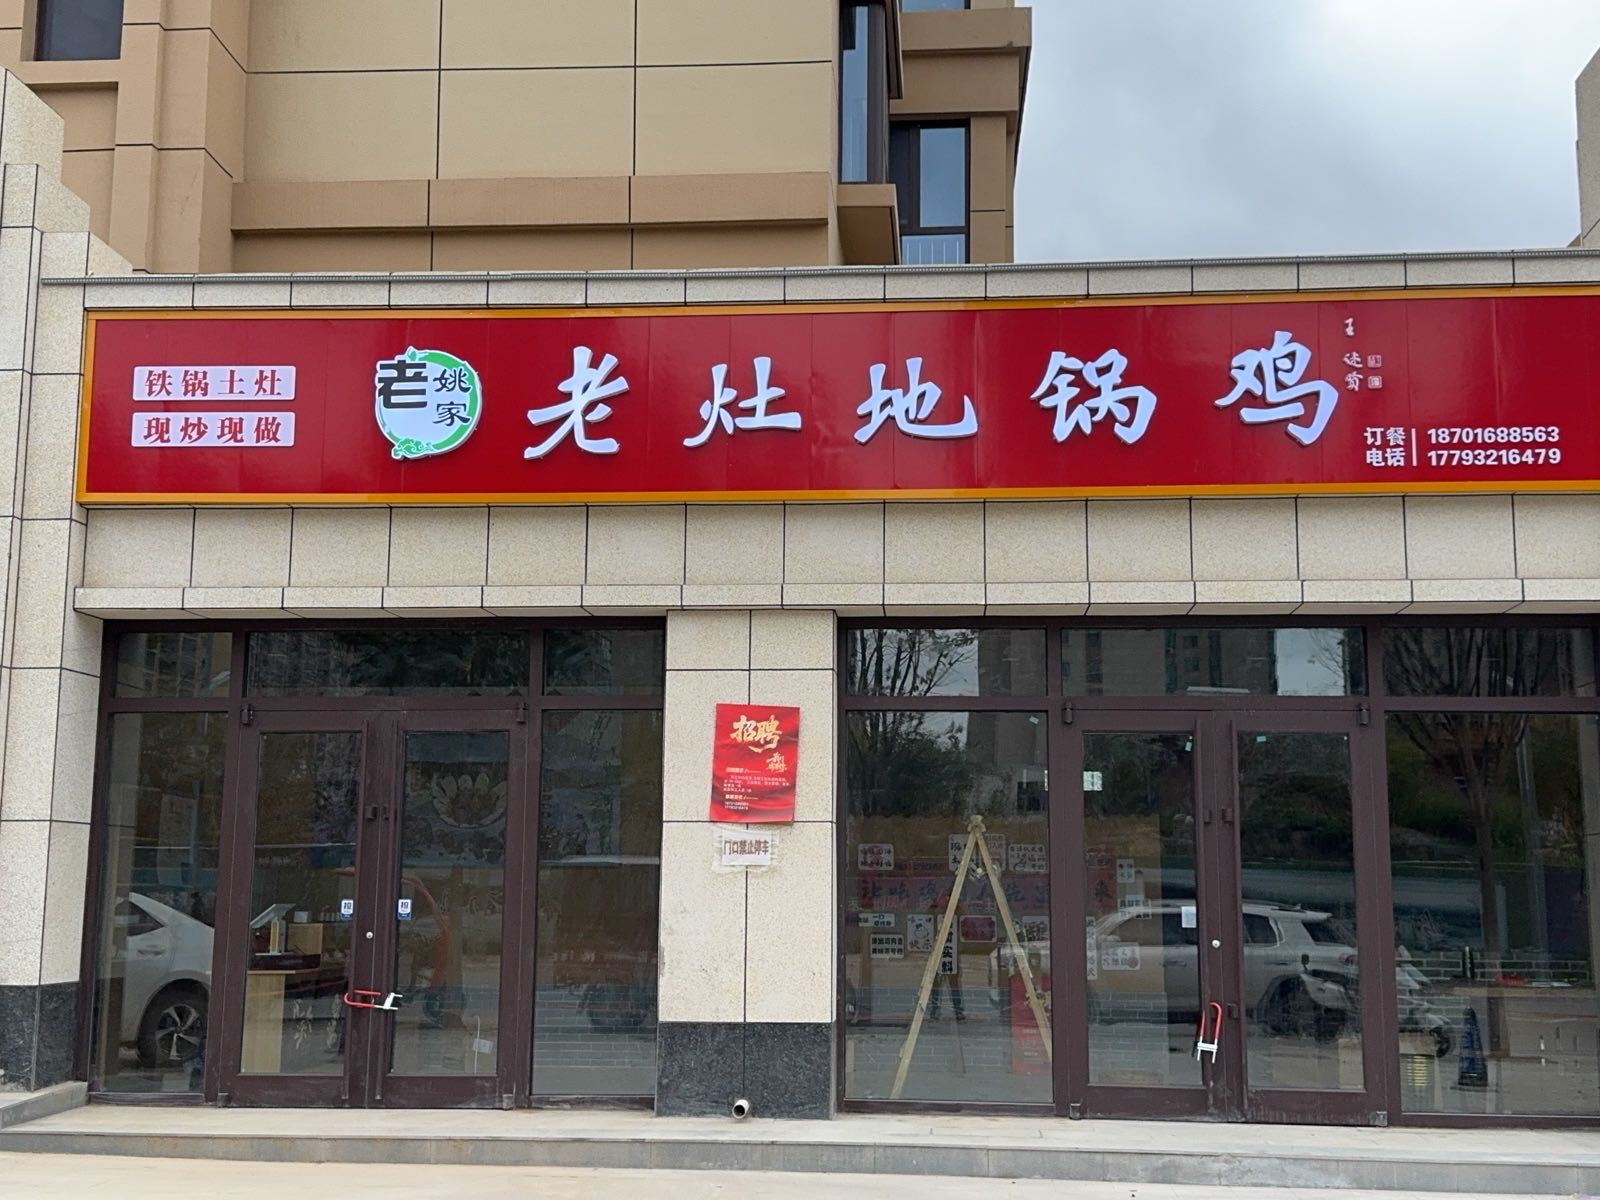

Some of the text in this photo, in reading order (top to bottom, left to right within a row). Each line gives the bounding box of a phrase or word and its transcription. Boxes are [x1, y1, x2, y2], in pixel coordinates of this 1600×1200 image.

[144, 369, 283, 398] 铁锅土灶
[523, 330, 1339, 460] 老灶地锅鸡
[143, 416, 283, 445] 现炒现做
[1363, 427, 1406, 447] 订餐
[1427, 426, 1560, 444] 18701688563
[1365, 448, 1406, 467] 电话
[1427, 448, 1562, 467] 17793216479
[730, 715, 782, 750] 招聘
[723, 838, 769, 855] 门口禁止停车
